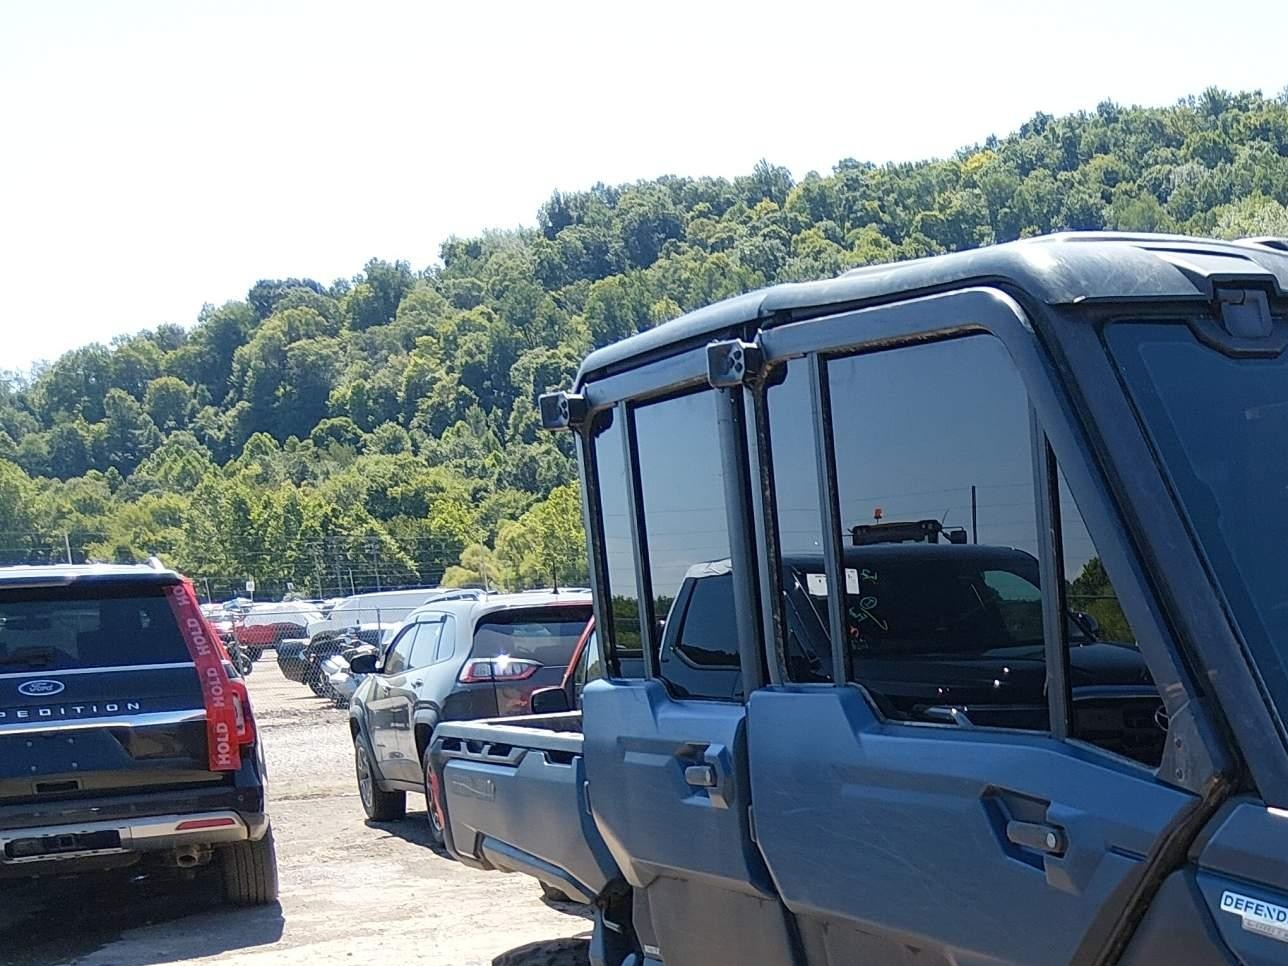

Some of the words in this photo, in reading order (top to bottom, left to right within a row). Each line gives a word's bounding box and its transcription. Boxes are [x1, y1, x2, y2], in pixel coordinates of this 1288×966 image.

[187, 618, 210, 656] HOLD
[28, 682, 53, 692] Ford
[207, 668, 225, 707] HOLD
[217, 722, 231, 765] HOLD
